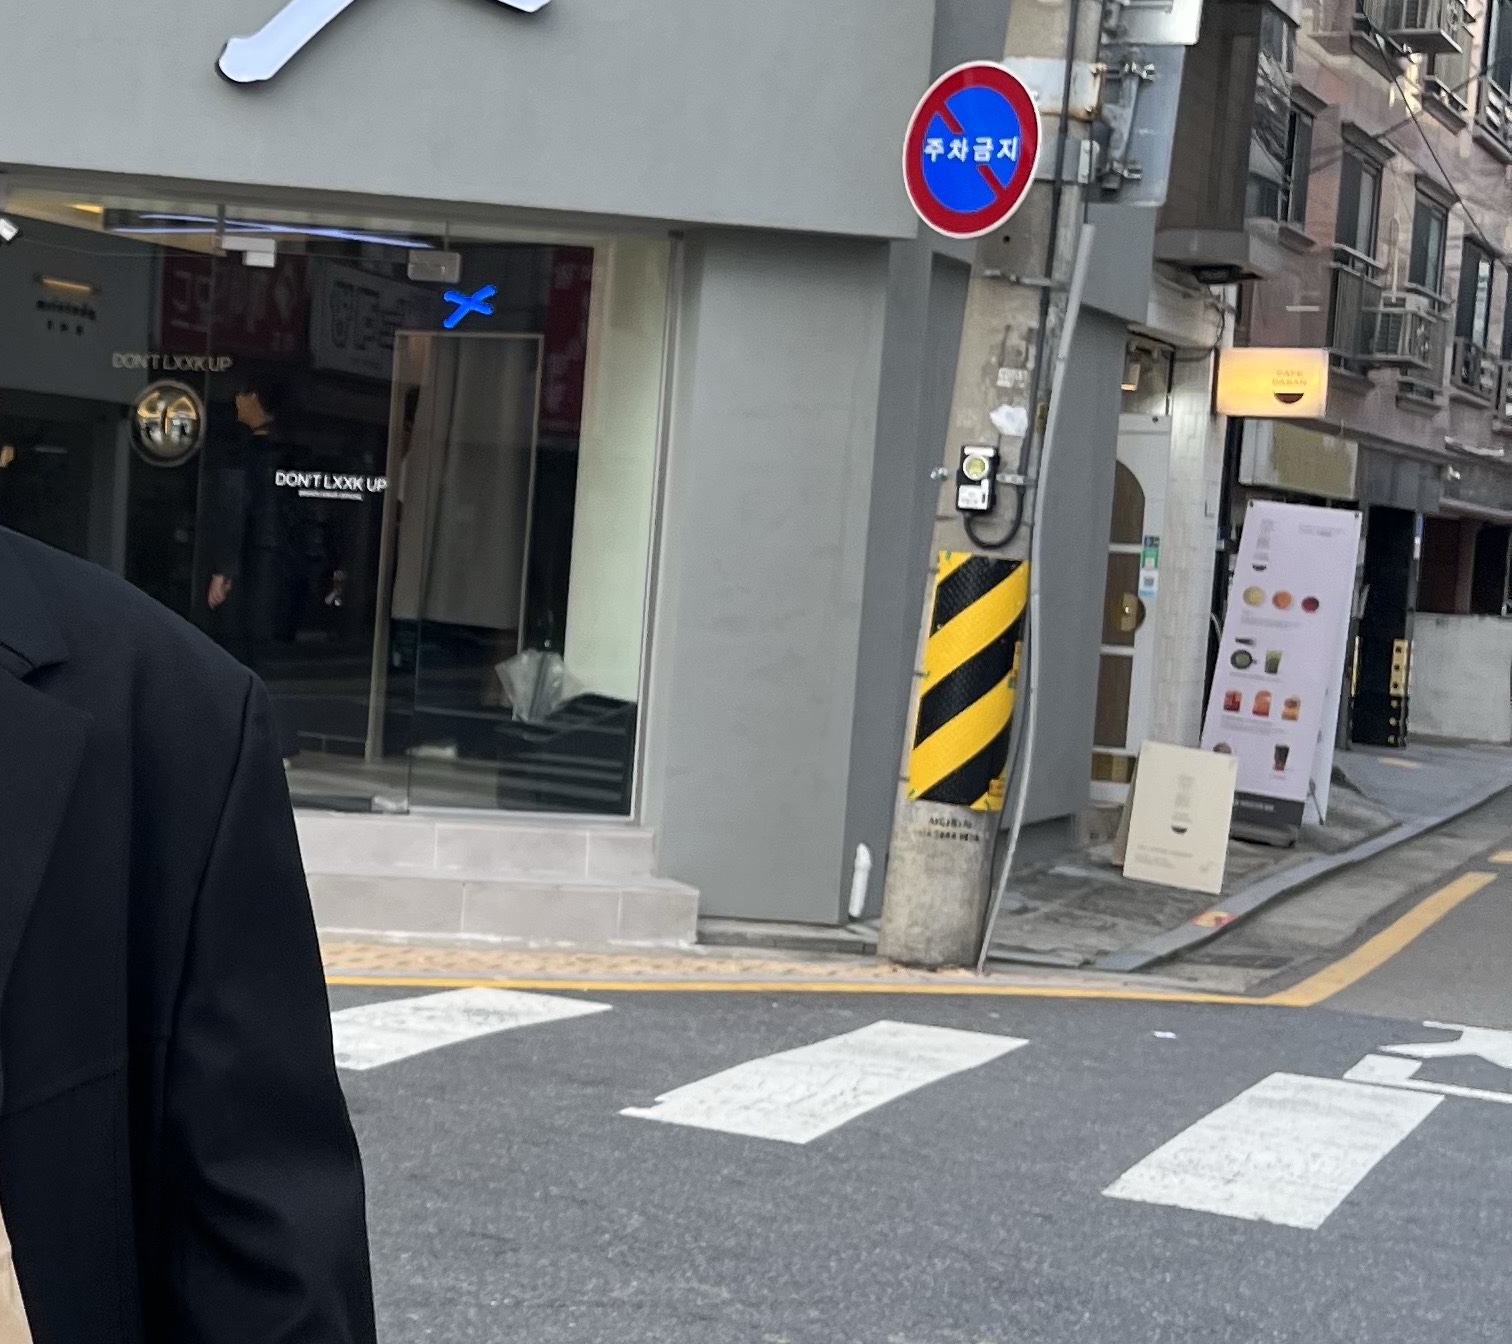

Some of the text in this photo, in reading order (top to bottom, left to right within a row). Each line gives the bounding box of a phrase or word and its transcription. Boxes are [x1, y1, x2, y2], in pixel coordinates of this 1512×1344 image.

[924, 136, 1017, 162] 주차금지
[209, 355, 234, 372] UP
[274, 469, 388, 493] DON'T LXXK UP
